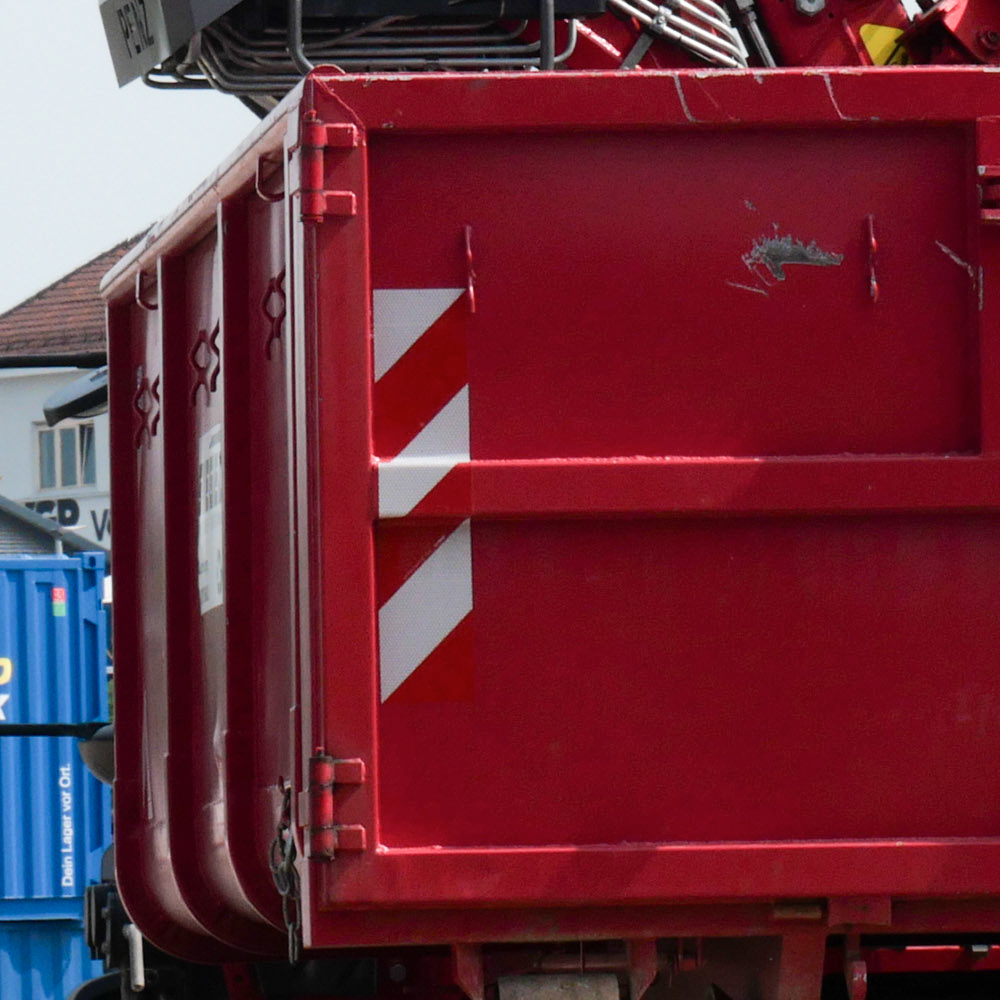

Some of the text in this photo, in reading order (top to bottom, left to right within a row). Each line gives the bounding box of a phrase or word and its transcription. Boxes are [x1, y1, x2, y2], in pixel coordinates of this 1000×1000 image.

[59, 763, 74, 888] Dein Lager vor Ort.
